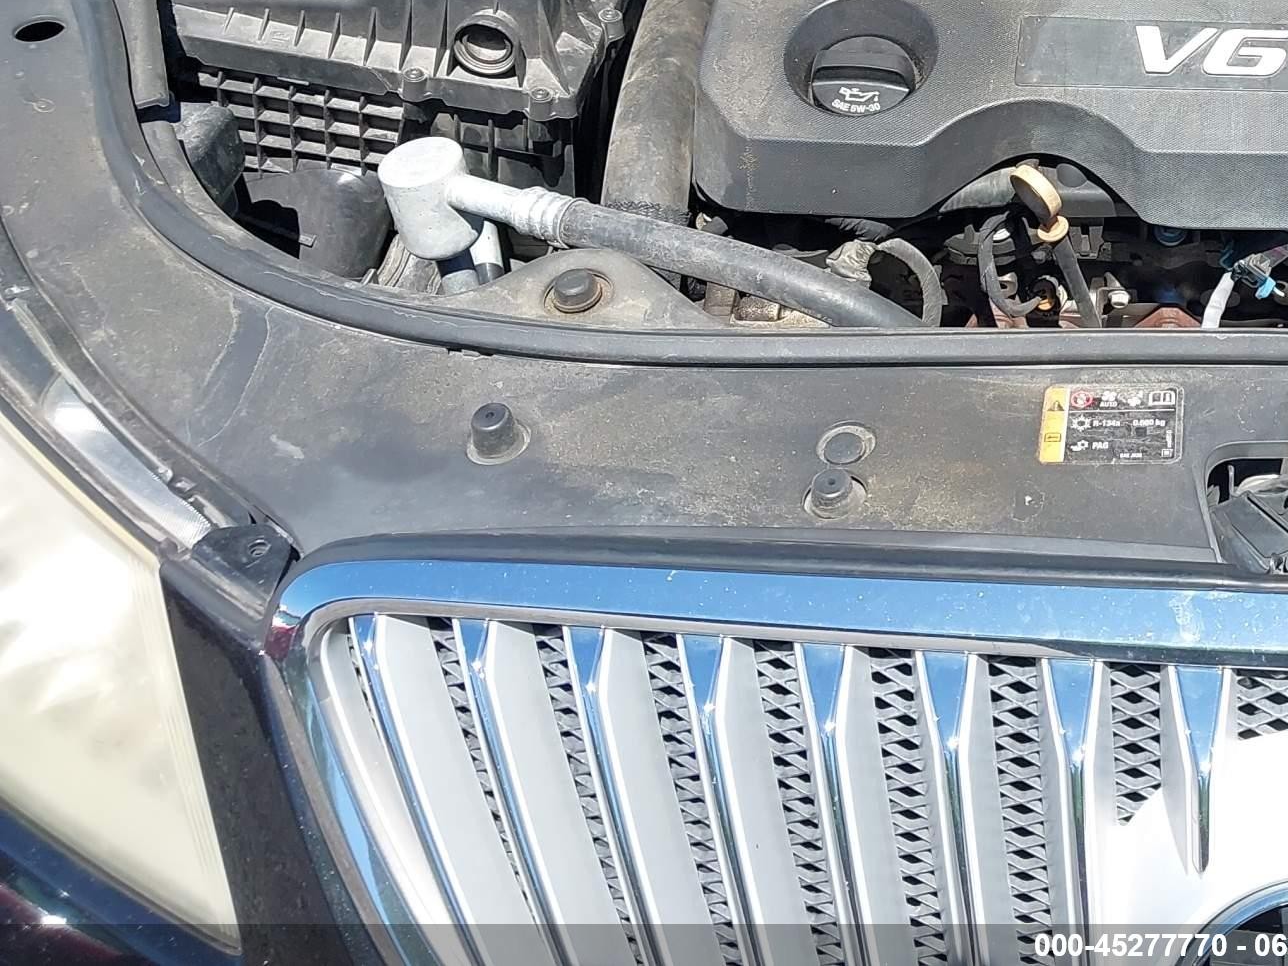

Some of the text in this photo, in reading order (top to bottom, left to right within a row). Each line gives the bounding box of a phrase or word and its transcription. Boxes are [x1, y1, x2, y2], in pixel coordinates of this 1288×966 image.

[831, 98, 881, 113] SAE 5W-30
[1091, 441, 1109, 450] PAG
